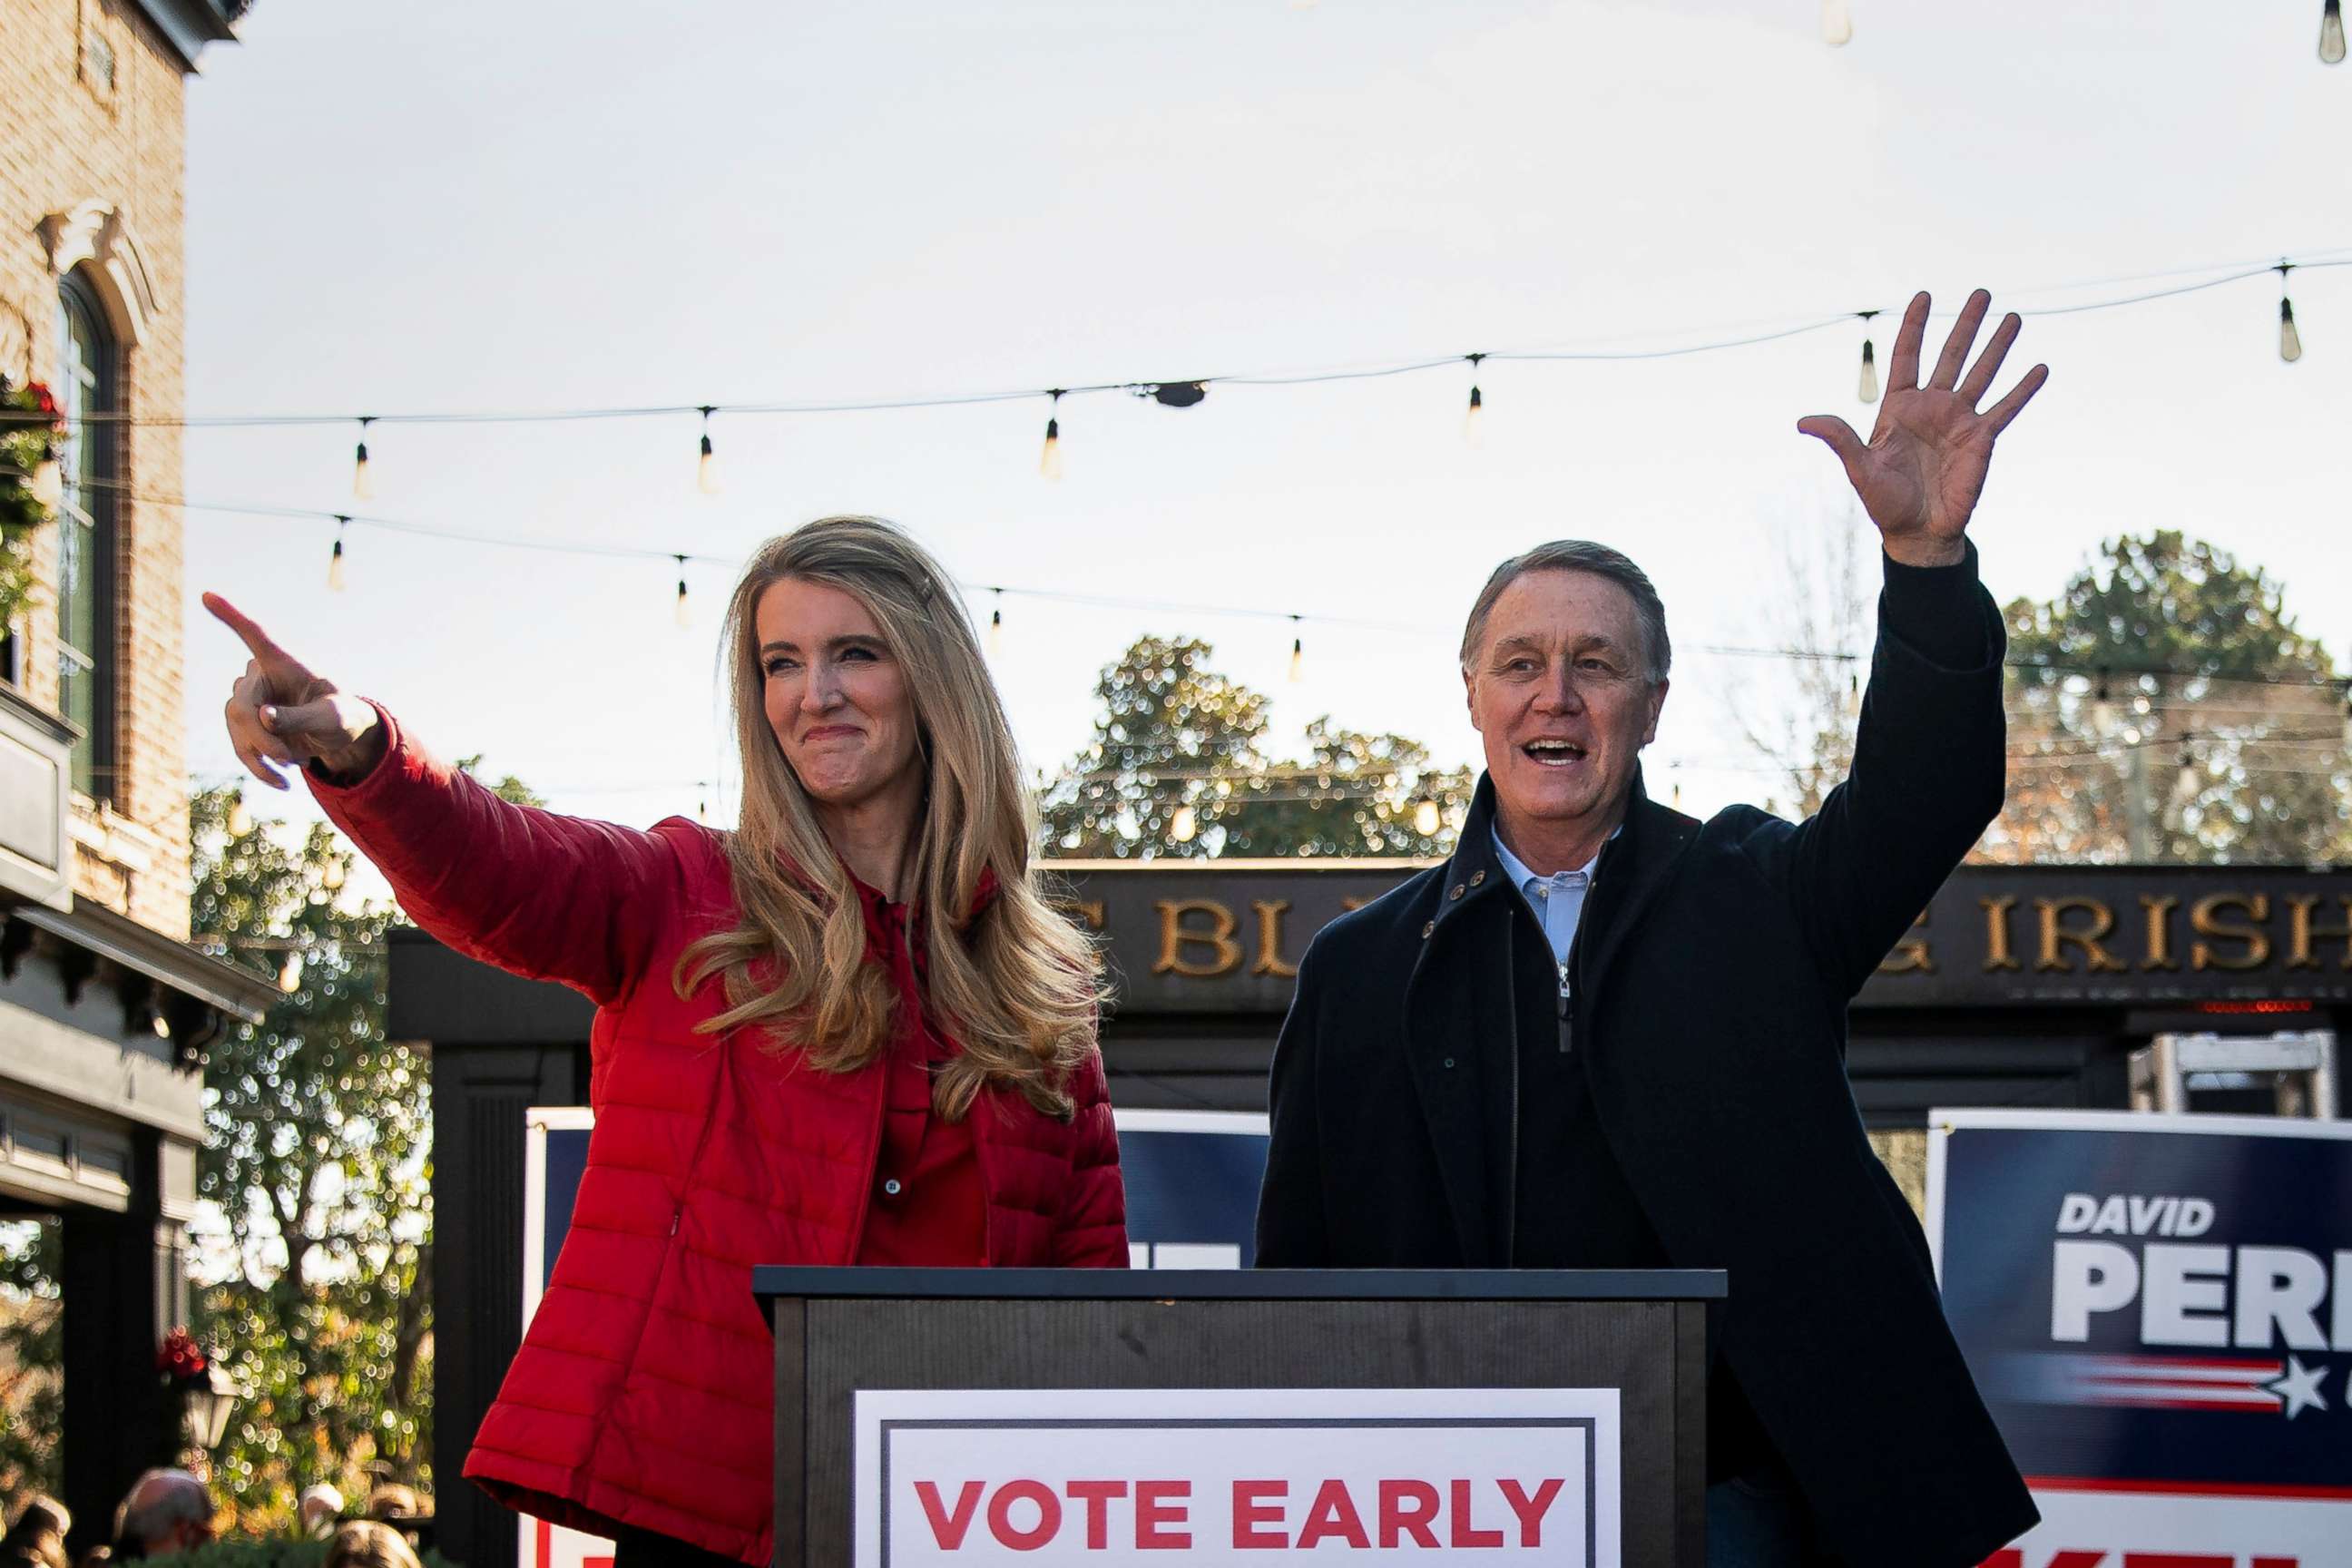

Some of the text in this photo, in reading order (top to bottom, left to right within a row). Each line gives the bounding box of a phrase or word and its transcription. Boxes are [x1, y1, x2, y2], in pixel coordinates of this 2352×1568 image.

[1979, 892, 2352, 971] IRISH
[2055, 1192, 2216, 1238] DAVID
[913, 1478, 1565, 1552] VOTE EARLY
